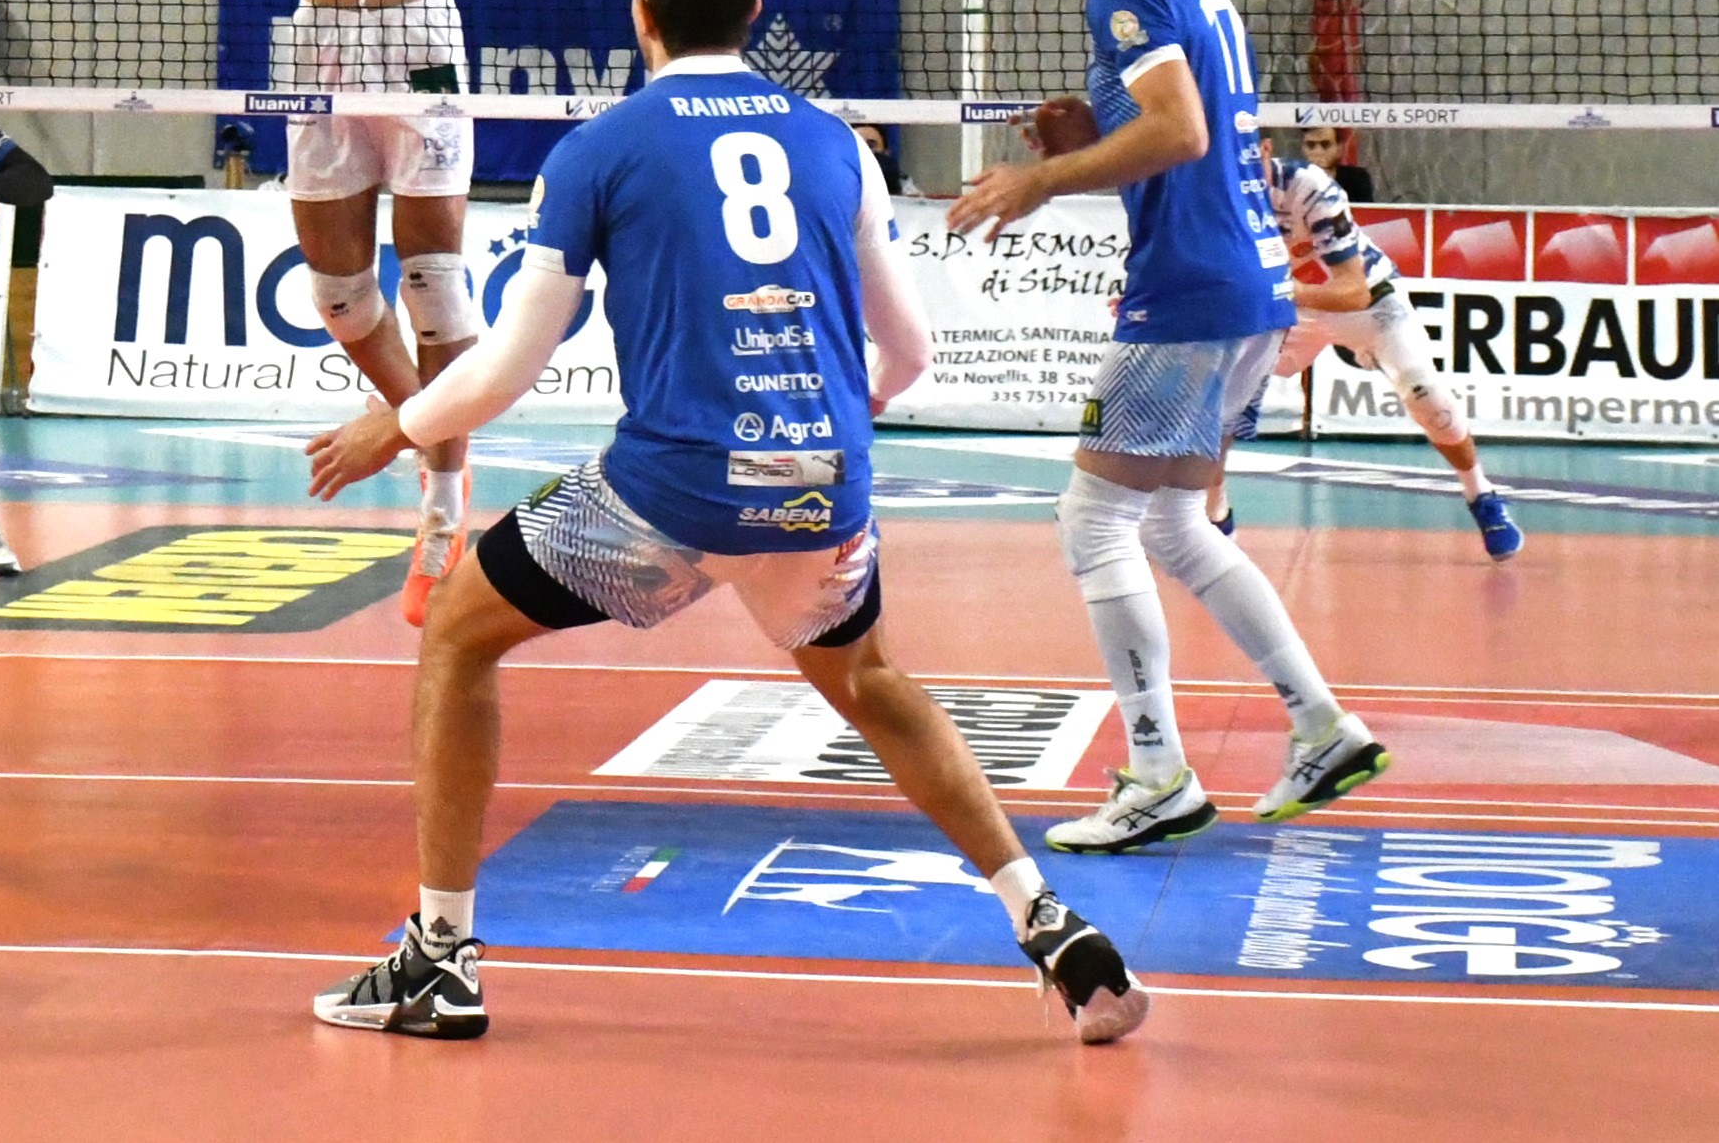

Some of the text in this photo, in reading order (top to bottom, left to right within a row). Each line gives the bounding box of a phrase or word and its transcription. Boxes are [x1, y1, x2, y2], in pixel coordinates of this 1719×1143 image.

[248, 95, 306, 112] luanvi
[669, 94, 791, 117] RAINERO
[963, 105, 1023, 123] luanv
[1318, 107, 1459, 125] VOLLEY & SPORT
[710, 130, 799, 265] 8
[981, 264, 1126, 301] di Sibilla
[726, 293, 813, 308] GRANDACAR
[941, 326, 1113, 345] TERMICA SANITARIA
[1043, 348, 1053, 363] E
[107, 348, 295, 389] Natural
[734, 373, 824, 393] GUNETTO
[934, 372, 959, 386] Via
[1038, 370, 1059, 384] 38
[990, 390, 1022, 403] 335
[1328, 379, 1477, 418] Mai
[769, 414, 833, 445] Agral
[738, 507, 832, 523] SABENA
